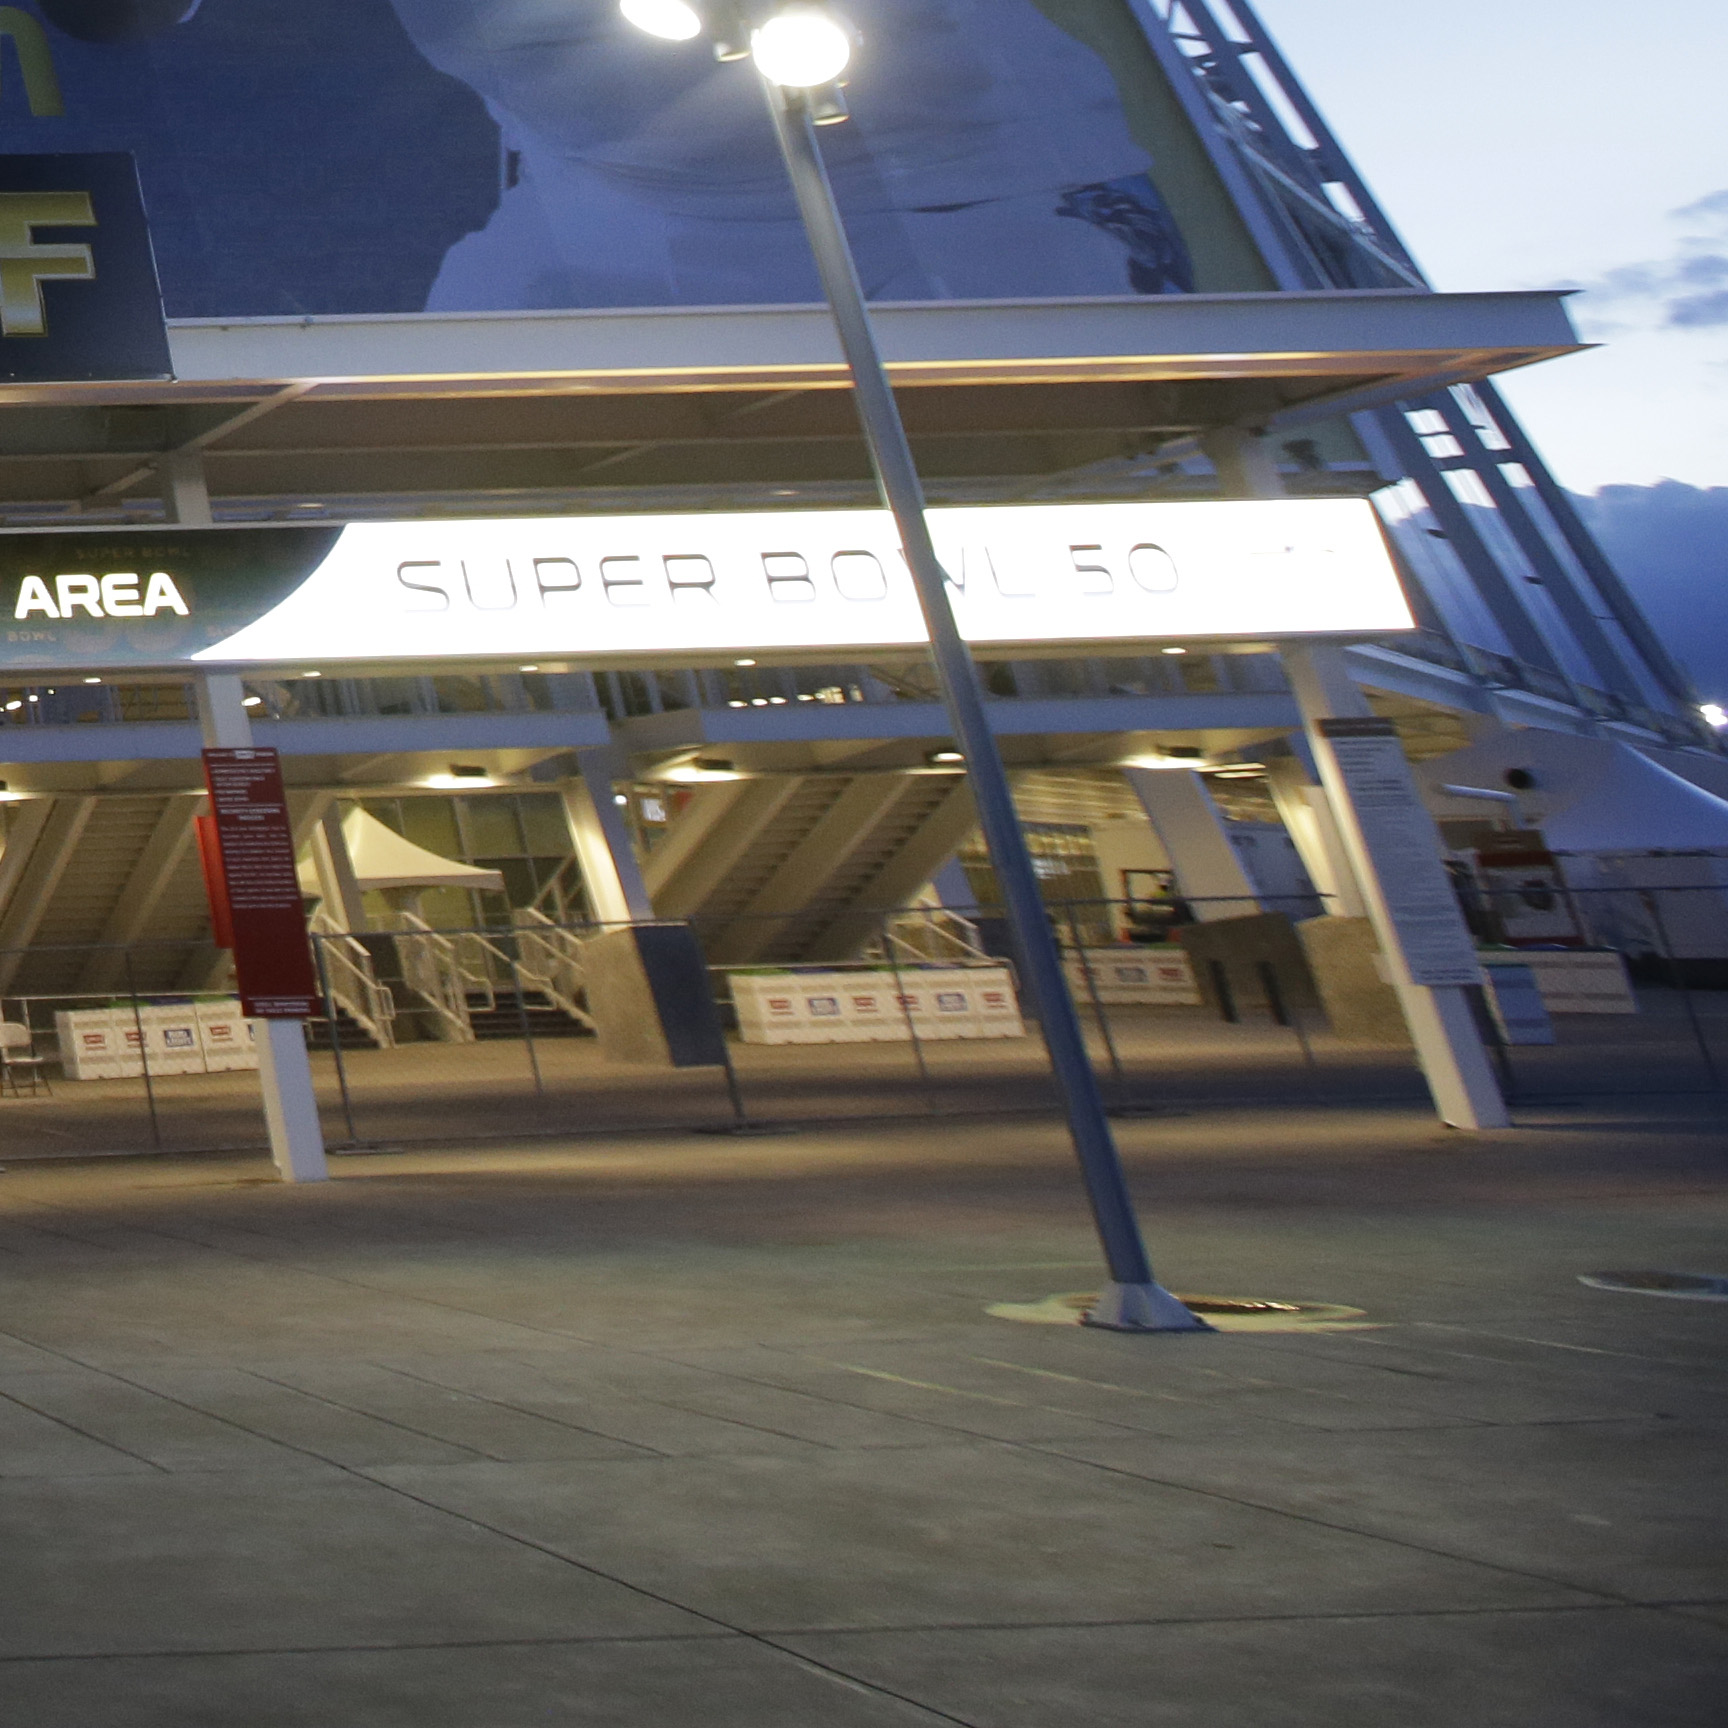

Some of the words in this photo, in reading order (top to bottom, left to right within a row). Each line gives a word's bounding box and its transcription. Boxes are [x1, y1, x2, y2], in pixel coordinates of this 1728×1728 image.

[13, 571, 192, 620] AREA
[395, 551, 720, 614] SUPER
[1068, 540, 1180, 596] 50
